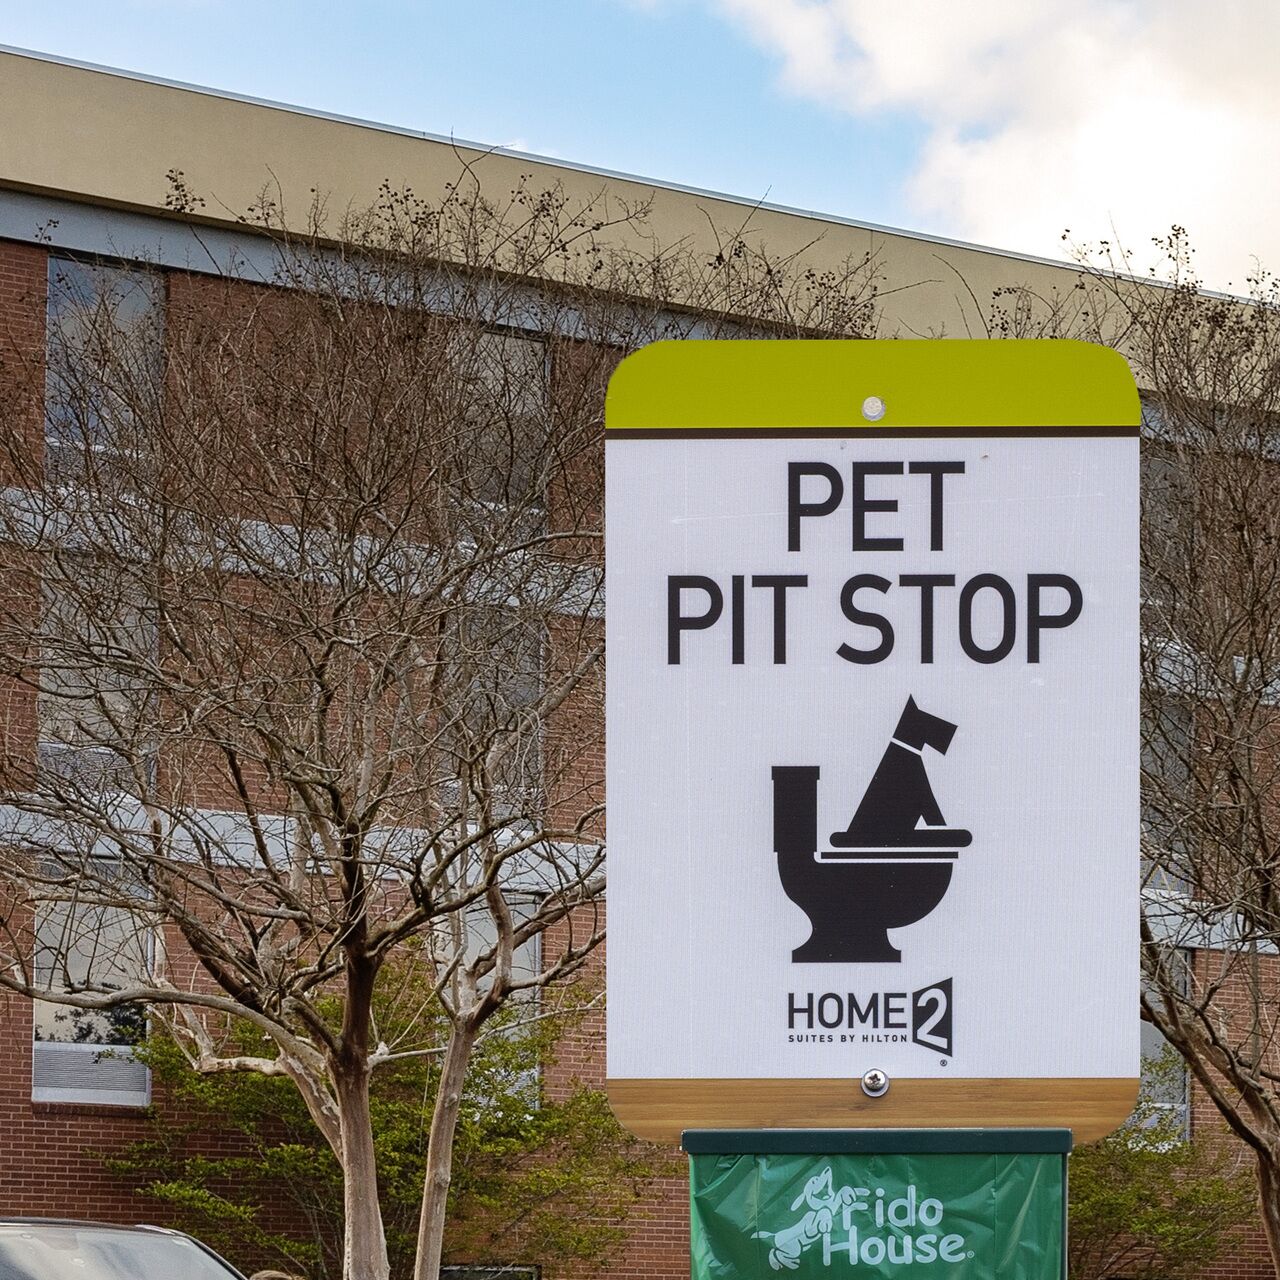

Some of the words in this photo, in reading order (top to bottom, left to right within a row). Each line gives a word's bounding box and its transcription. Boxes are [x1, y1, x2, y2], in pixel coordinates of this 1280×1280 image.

[787, 460, 966, 552] PET
[667, 574, 809, 665] PIT
[836, 573, 1084, 665] STOP
[788, 1034, 834, 1043] SUITES
[840, 1034, 855, 1043] BY
[862, 1034, 908, 1043] HILTON
[842, 1184, 944, 1231] Fido
